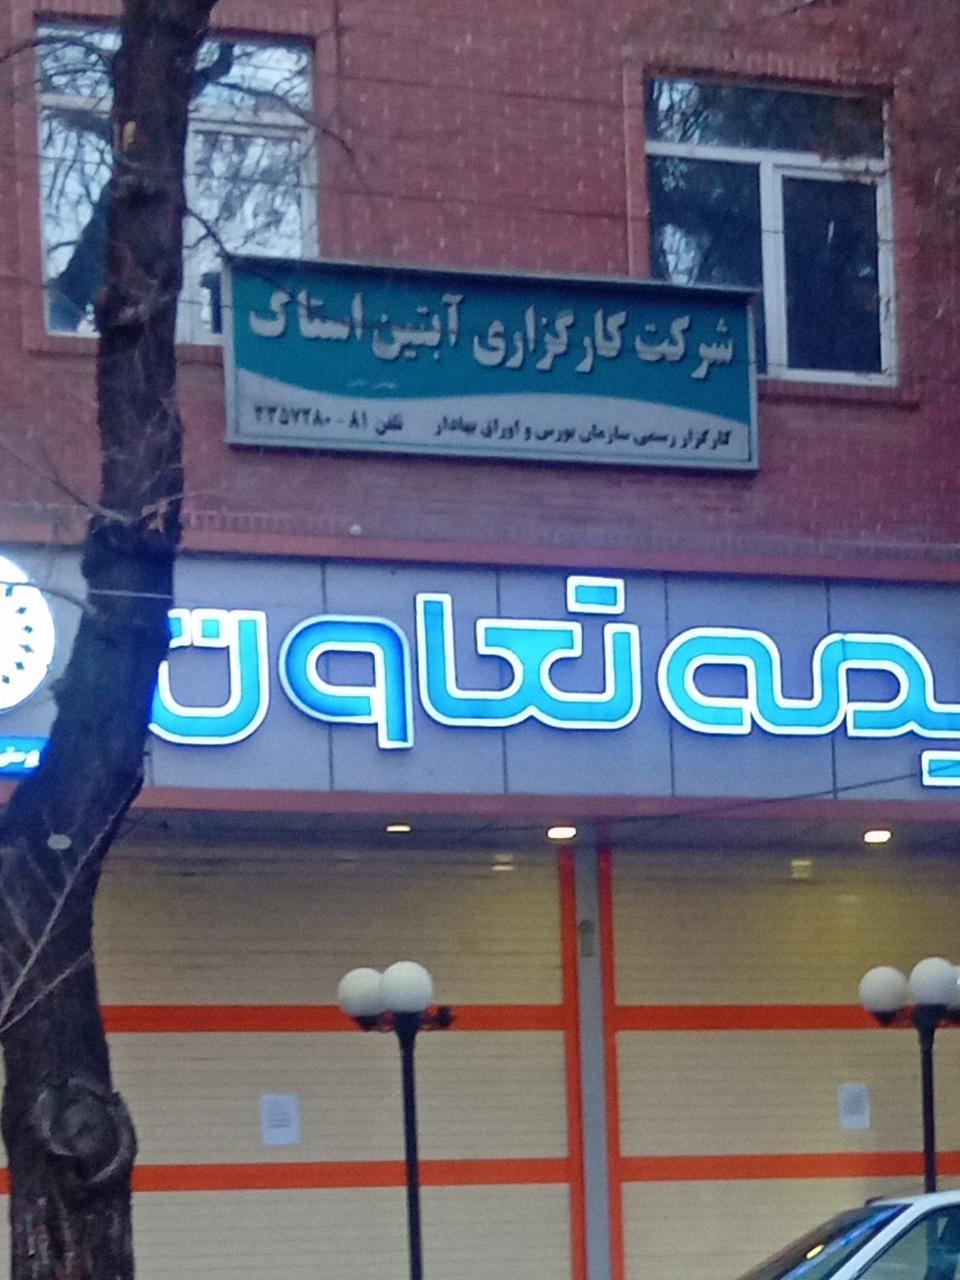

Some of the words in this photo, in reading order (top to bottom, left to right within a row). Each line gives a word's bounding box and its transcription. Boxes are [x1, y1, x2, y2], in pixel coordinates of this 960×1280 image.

[249, 288, 364, 341] استاک
[371, 292, 464, 361] آبتین
[473, 304, 628, 374] کارگزاری
[633, 315, 734, 379] شرکت
[523, 427, 533, 441] و
[148, 575, 642, 750] تعاون
